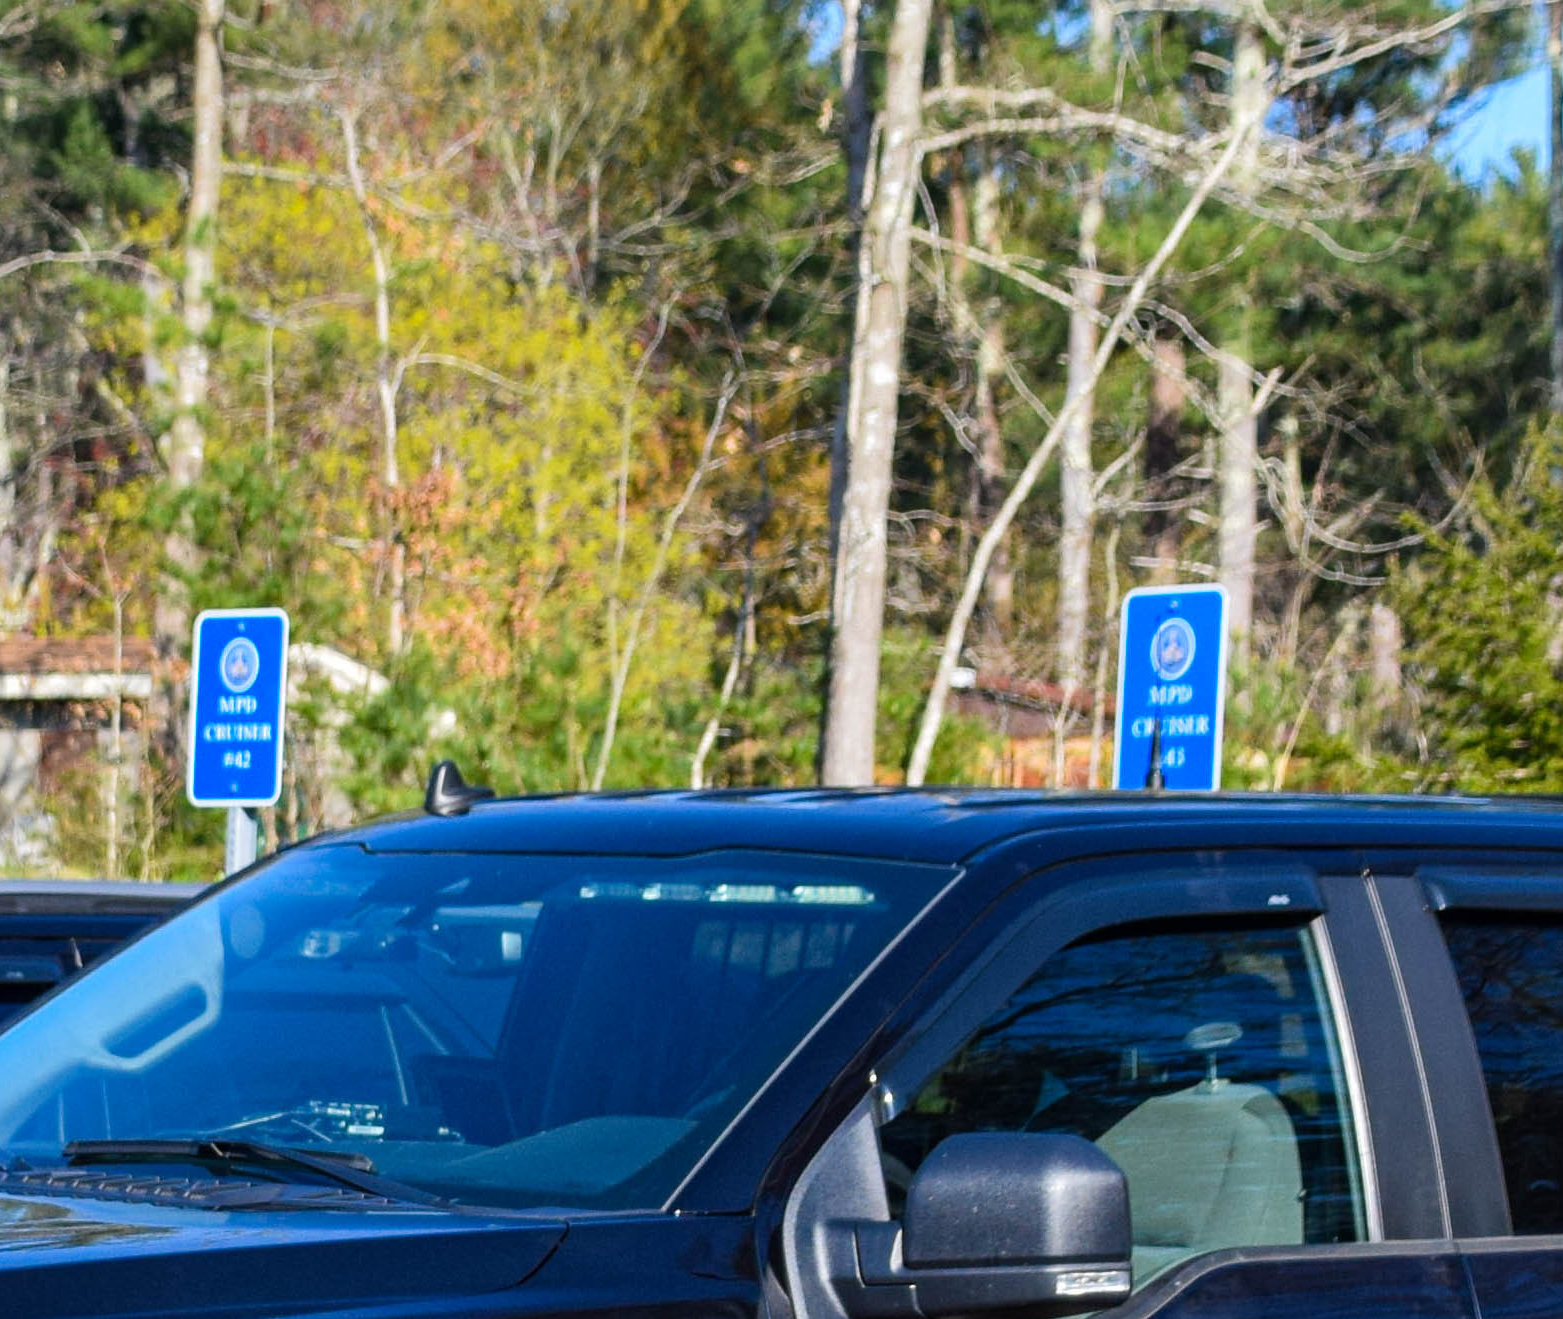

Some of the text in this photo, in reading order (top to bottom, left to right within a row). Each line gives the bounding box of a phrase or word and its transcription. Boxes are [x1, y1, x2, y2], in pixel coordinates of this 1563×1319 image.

[1148, 684, 1193, 705] MPD
[219, 696, 257, 714] MPD
[204, 723, 272, 742] CRUISER
[223, 750, 252, 768] #42
